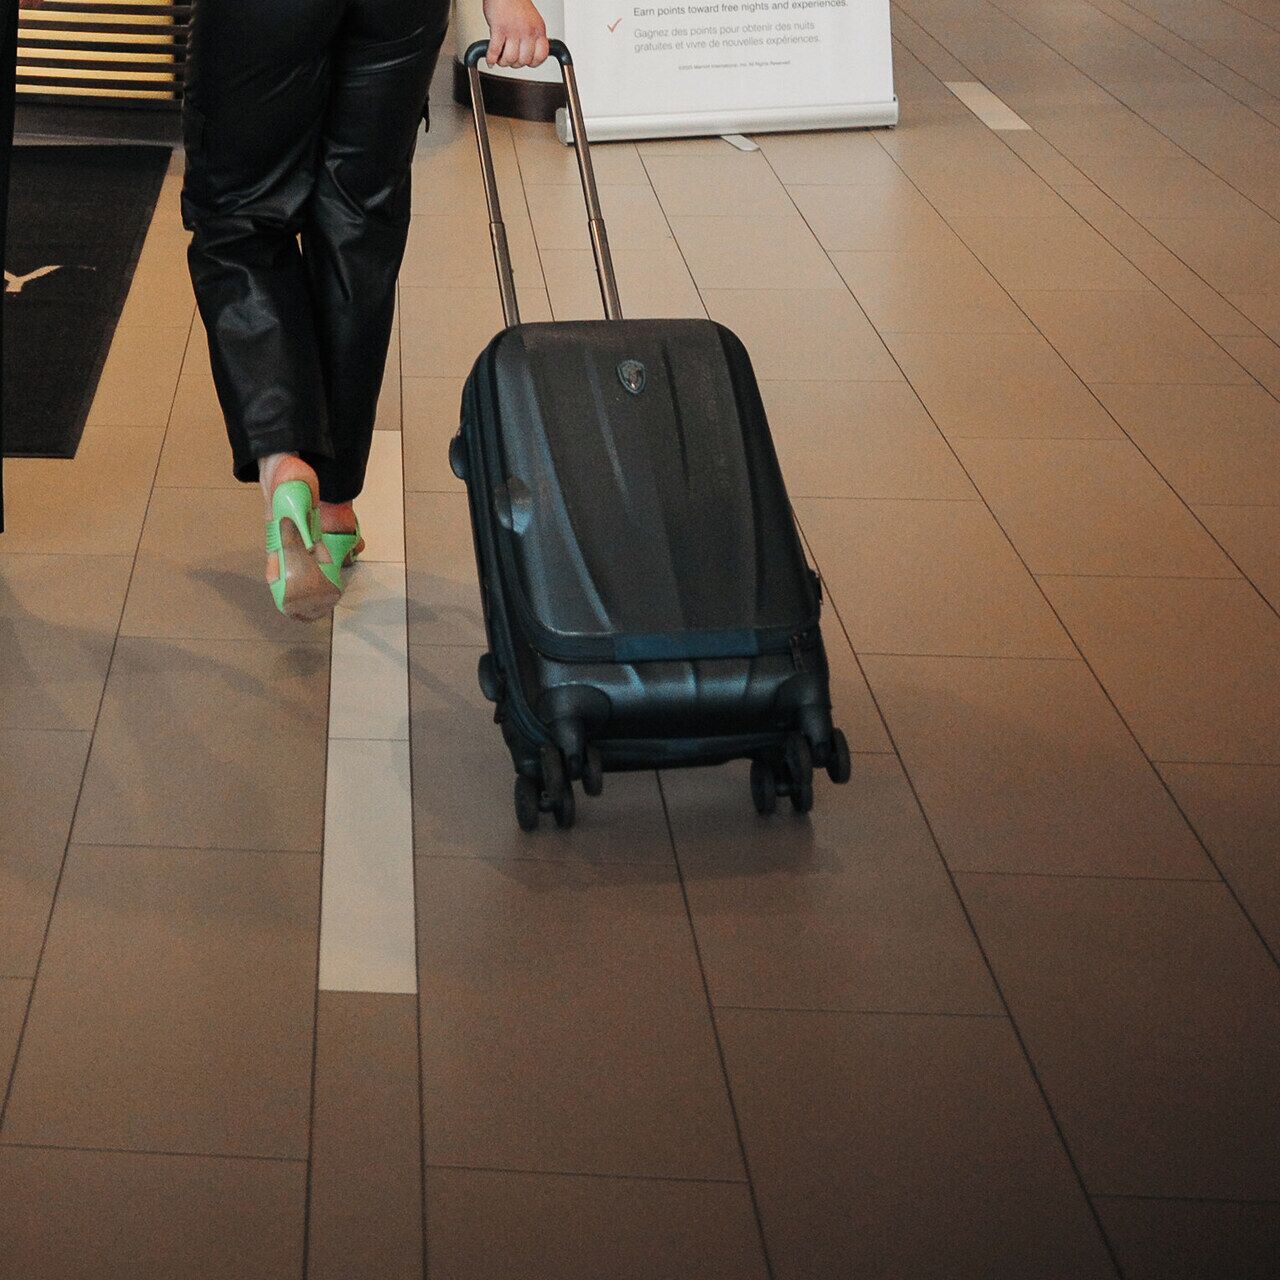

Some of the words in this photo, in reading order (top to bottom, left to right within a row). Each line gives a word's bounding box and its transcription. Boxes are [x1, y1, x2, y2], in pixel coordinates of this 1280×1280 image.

[634, 7, 655, 17] Earn
[658, 6, 685, 17] points
[688, 4, 719, 14] toward
[721, 3, 739, 12] free
[741, 1, 769, 12] nights
[772, 1, 788, 10] and
[792, 0, 848, 10] experiences.
[634, 29, 668, 39] Gagnez
[671, 27, 688, 37] des
[690, 26, 717, 36] points
[720, 26, 740, 35] pour
[742, 23, 772, 33] obtenir
[775, 23, 791, 31] des
[794, 21, 815, 30] nuits
[634, 42, 672, 53] gratuites
[675, 41, 684, 50] et
[686, 41, 706, 49] vivre
[709, 39, 720, 48] de
[723, 37, 764, 47] nouvelles
[766, 35, 820, 46] expériences.
